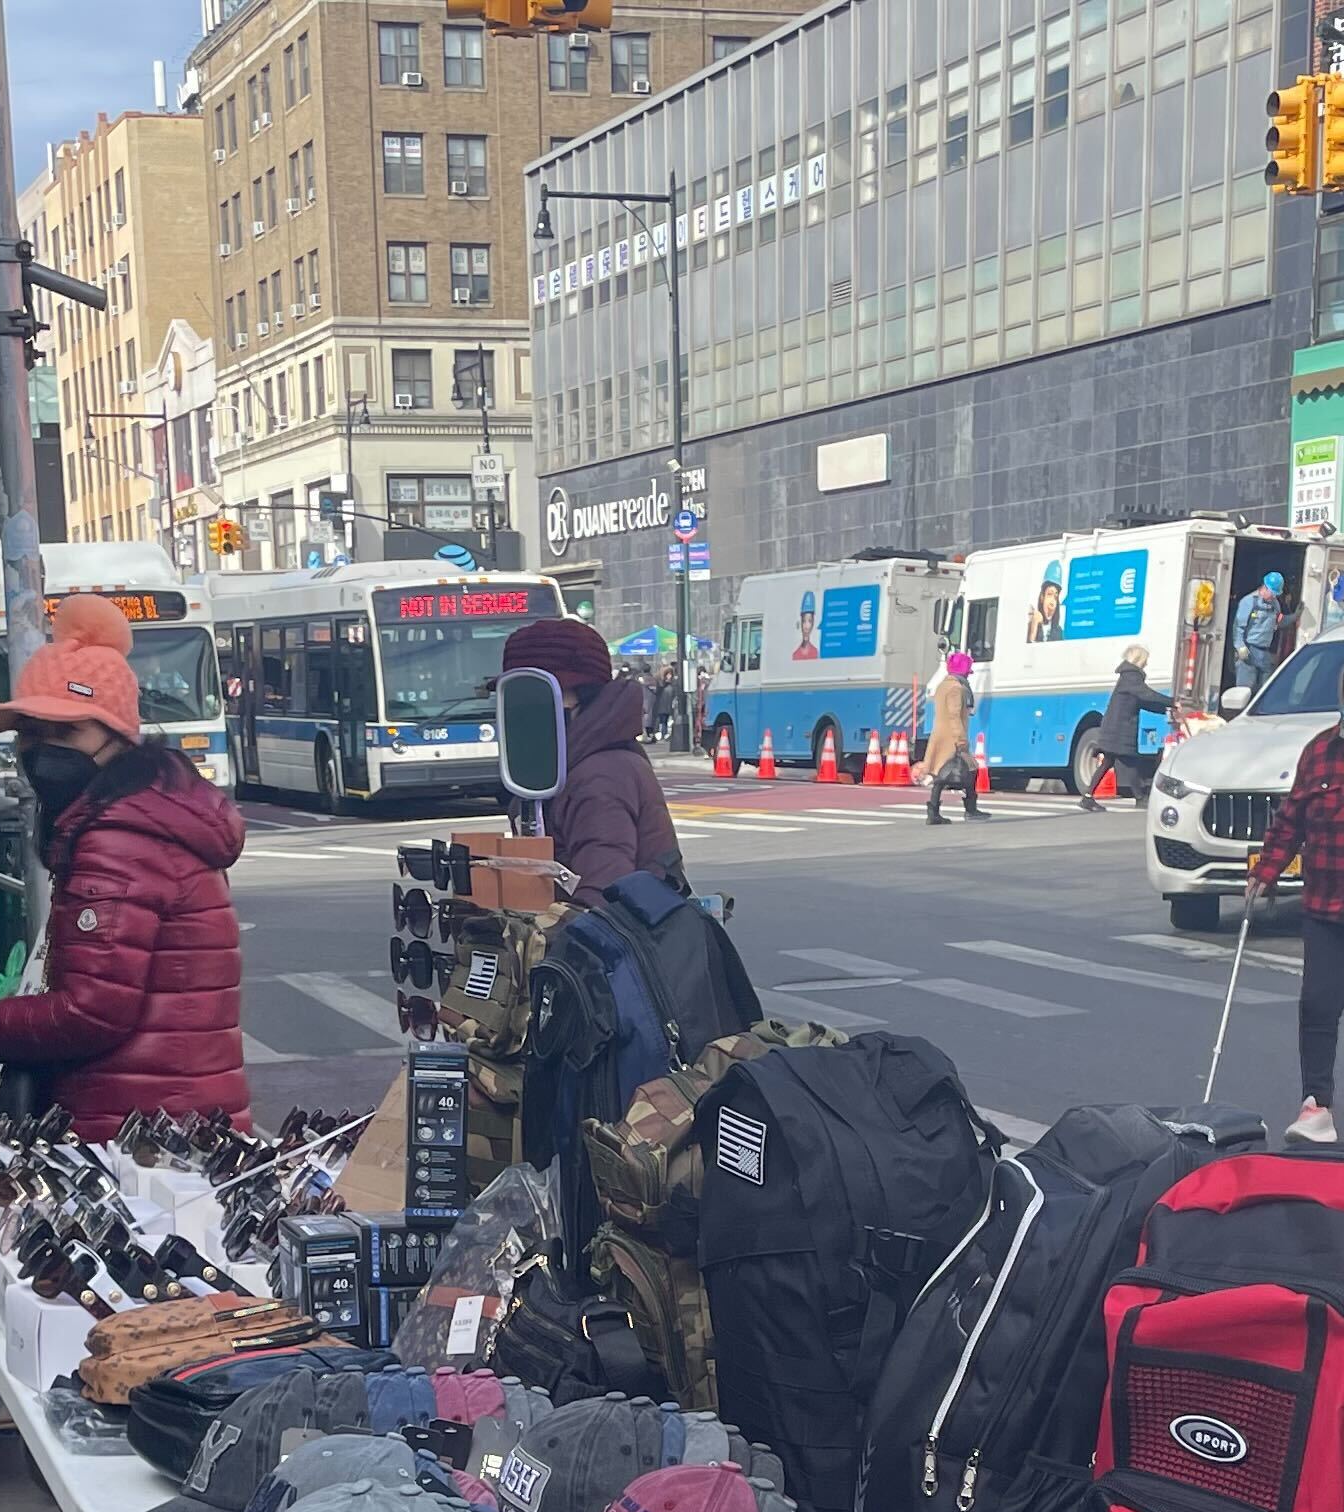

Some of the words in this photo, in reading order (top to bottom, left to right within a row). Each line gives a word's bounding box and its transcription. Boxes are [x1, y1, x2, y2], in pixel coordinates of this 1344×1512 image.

[479, 458, 496, 470] NO
[399, 595, 434, 618] NOT
[440, 594, 457, 616] IN
[461, 591, 529, 616] SERVICE
[423, 728, 449, 740] 8105
[438, 1096, 455, 1108] 40
[332, 1278, 349, 1290] 40
[1195, 1431, 1238, 1455] SPORT
